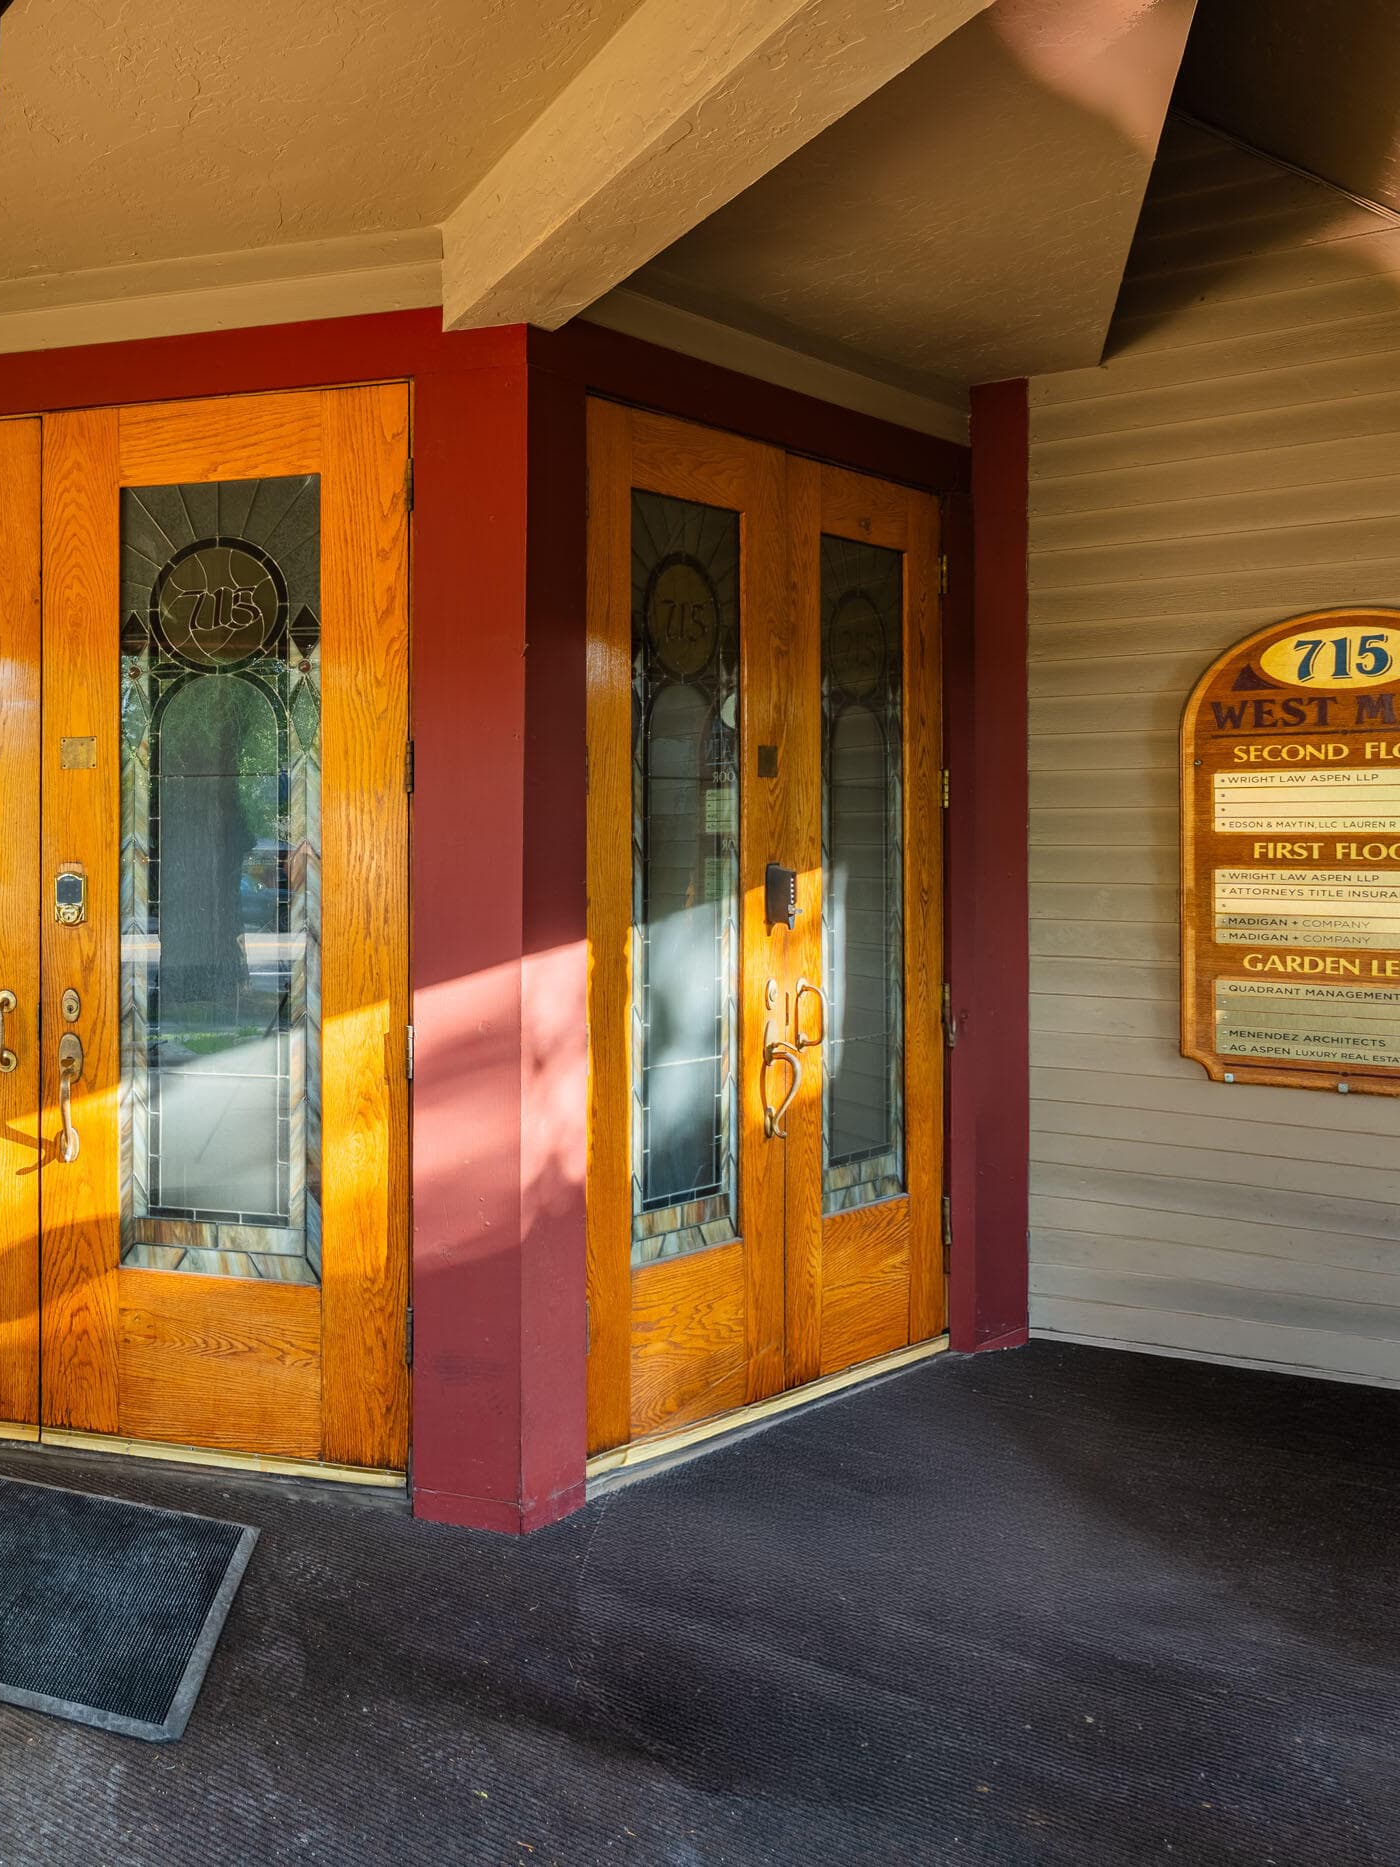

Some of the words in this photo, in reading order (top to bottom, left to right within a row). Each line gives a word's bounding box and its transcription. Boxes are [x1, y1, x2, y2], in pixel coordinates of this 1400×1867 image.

[178, 586, 263, 632] 715
[1294, 633, 1393, 683] 715
[1211, 696, 1337, 730] WEST
[1233, 743, 1349, 763] SECOND
[1228, 775, 1275, 784] WRIGHT
[1280, 775, 1306, 783] LAW
[1310, 774, 1351, 782] ASPEN
[1356, 773, 1379, 782] LLP
[1228, 821, 1263, 829] EDSON
[1266, 821, 1273, 829] &
[1253, 842, 1324, 860] FIRST
[1228, 872, 1276, 880] WRIGHT
[1280, 873, 1307, 881] LAW
[1311, 874, 1352, 882] ASPEN
[1357, 874, 1380, 882] LLP
[1229, 887, 1304, 897] ATTORNEYS
[1308, 889, 1344, 897] TITLE
[1228, 917, 1288, 926] MADIGAN
[1302, 919, 1371, 929] COMPANY
[1229, 932, 1289, 941] MADIGAN
[1303, 934, 1371, 944] COMPANY
[1243, 953, 1360, 976] GARDEN
[1229, 984, 1301, 995] QUADRANT
[1305, 988, 1400, 1001] MANAGEMENT
[1229, 1030, 1299, 1042] MENENDEZ
[1303, 1034, 1386, 1047] ARCHITECTS
[1229, 1044, 1246, 1052] AG
[1250, 1045, 1291, 1055] ASPEN
[1295, 1049, 1337, 1059] LUXURY
[1341, 1052, 1369, 1061] REAL
